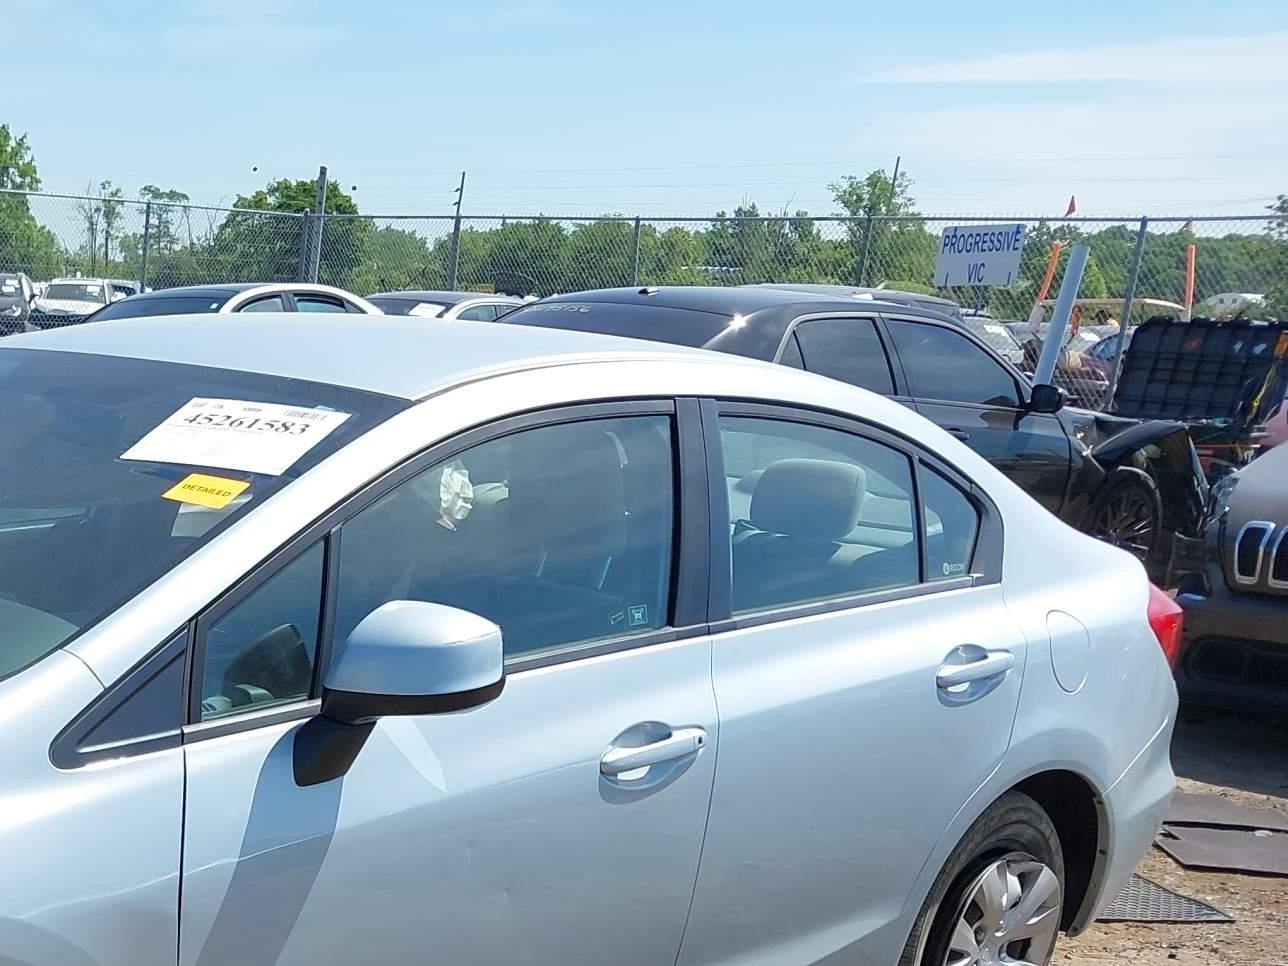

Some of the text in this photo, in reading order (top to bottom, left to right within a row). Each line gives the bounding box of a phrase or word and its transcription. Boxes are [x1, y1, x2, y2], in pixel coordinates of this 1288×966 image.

[942, 230, 1021, 254] PROGRESSIVE
[968, 263, 986, 283] VIC
[183, 412, 311, 436] 45261583
[182, 483, 232, 497] DETAILED
